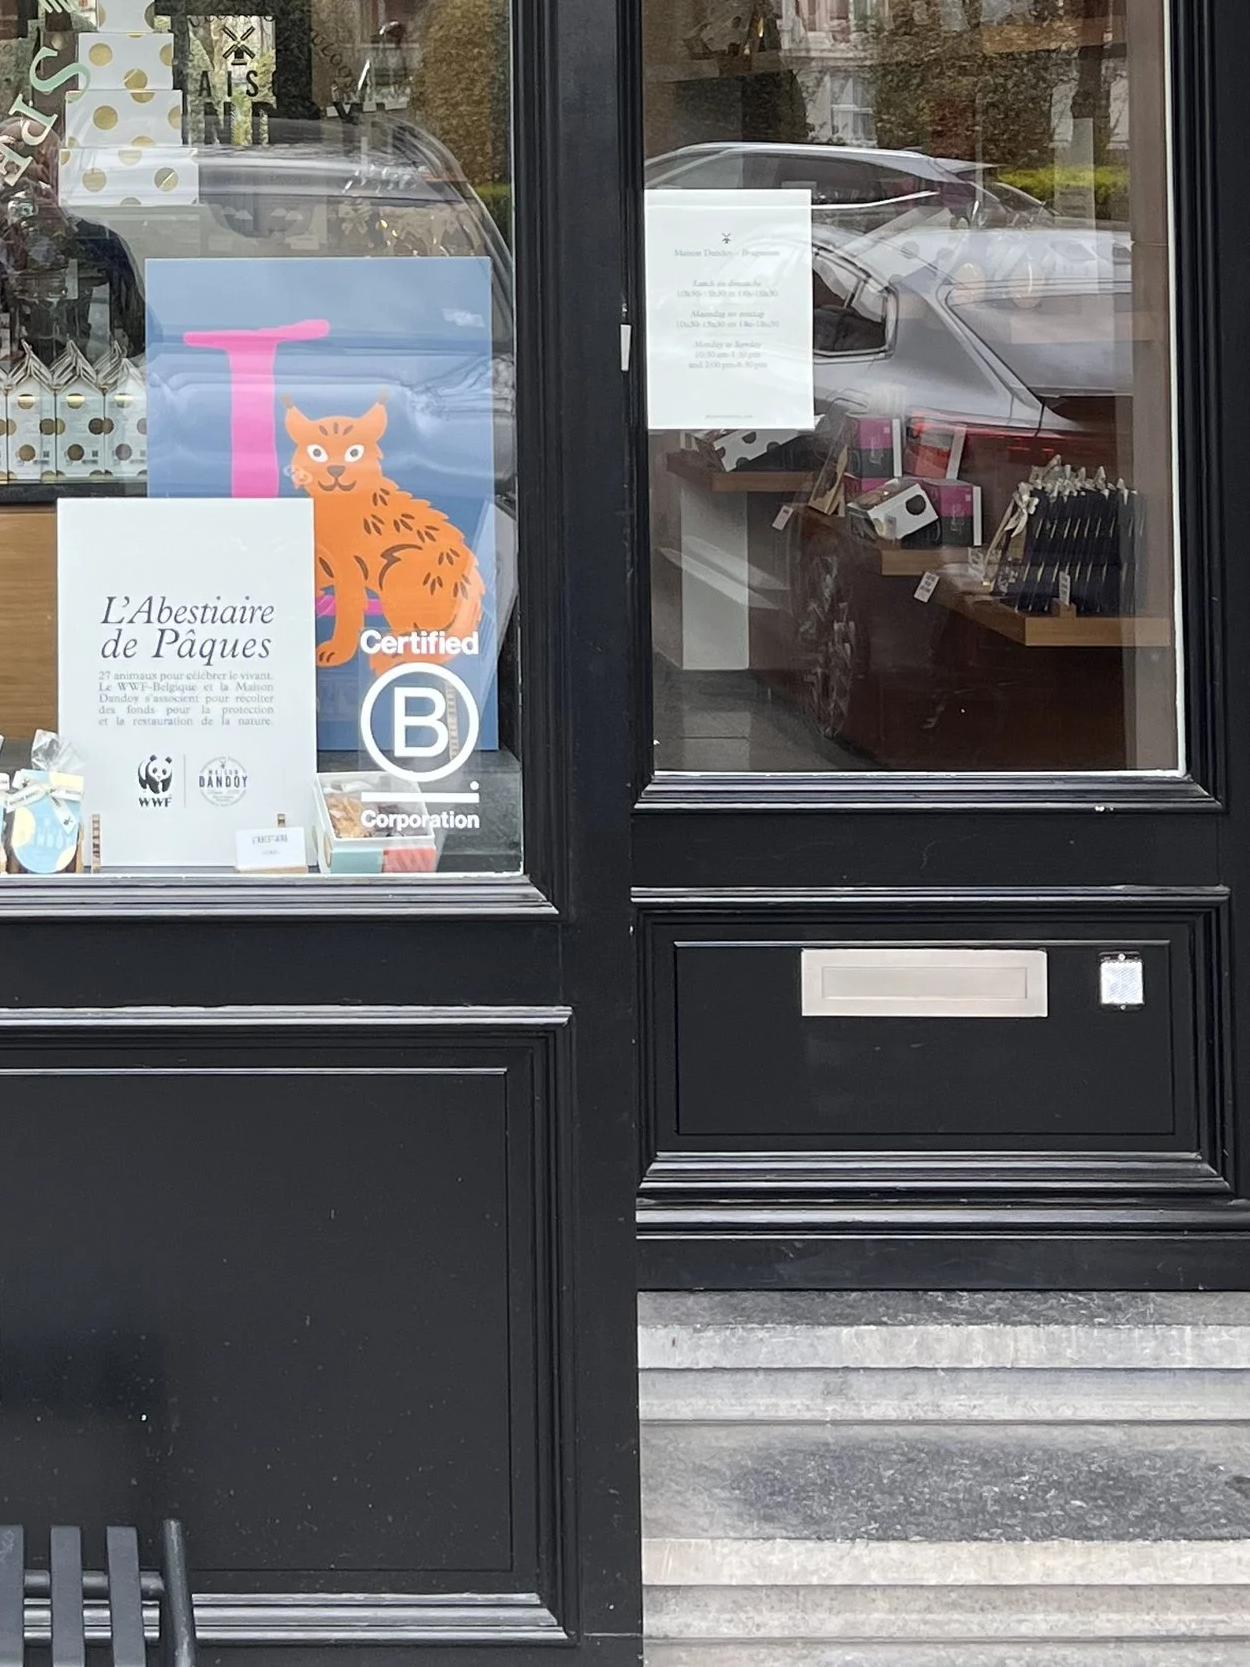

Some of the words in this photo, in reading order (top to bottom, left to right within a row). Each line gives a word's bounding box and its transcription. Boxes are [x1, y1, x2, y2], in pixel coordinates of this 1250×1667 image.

[101, 629, 137, 659] de
[151, 628, 271, 667] Pâques
[360, 629, 479, 655] Certified
[98, 671, 111, 680] 27
[114, 671, 157, 680] animaux
[160, 672, 184, 682] pour
[229, 671, 239, 680] le
[98, 682, 112, 691] Le
[203, 683, 213, 691] et
[220, 682, 229, 691] la
[235, 682, 274, 691] Maison
[98, 694, 140, 704] Dandoy
[205, 695, 229, 704] pour
[98, 705, 115, 714] des
[127, 705, 156, 714] fonds
[166, 707, 190, 716] pour
[201, 705, 210, 714] la
[222, 705, 274, 715] protection
[98, 717, 108, 726] et
[116, 716, 125, 726] la
[133, 716, 193, 726] restauration
[201, 716, 214, 726] de
[394, 687, 449, 757] B
[199, 775, 248, 788] DANDOY
[138, 797, 172, 807] WWF
[361, 810, 480, 831] Corporation
